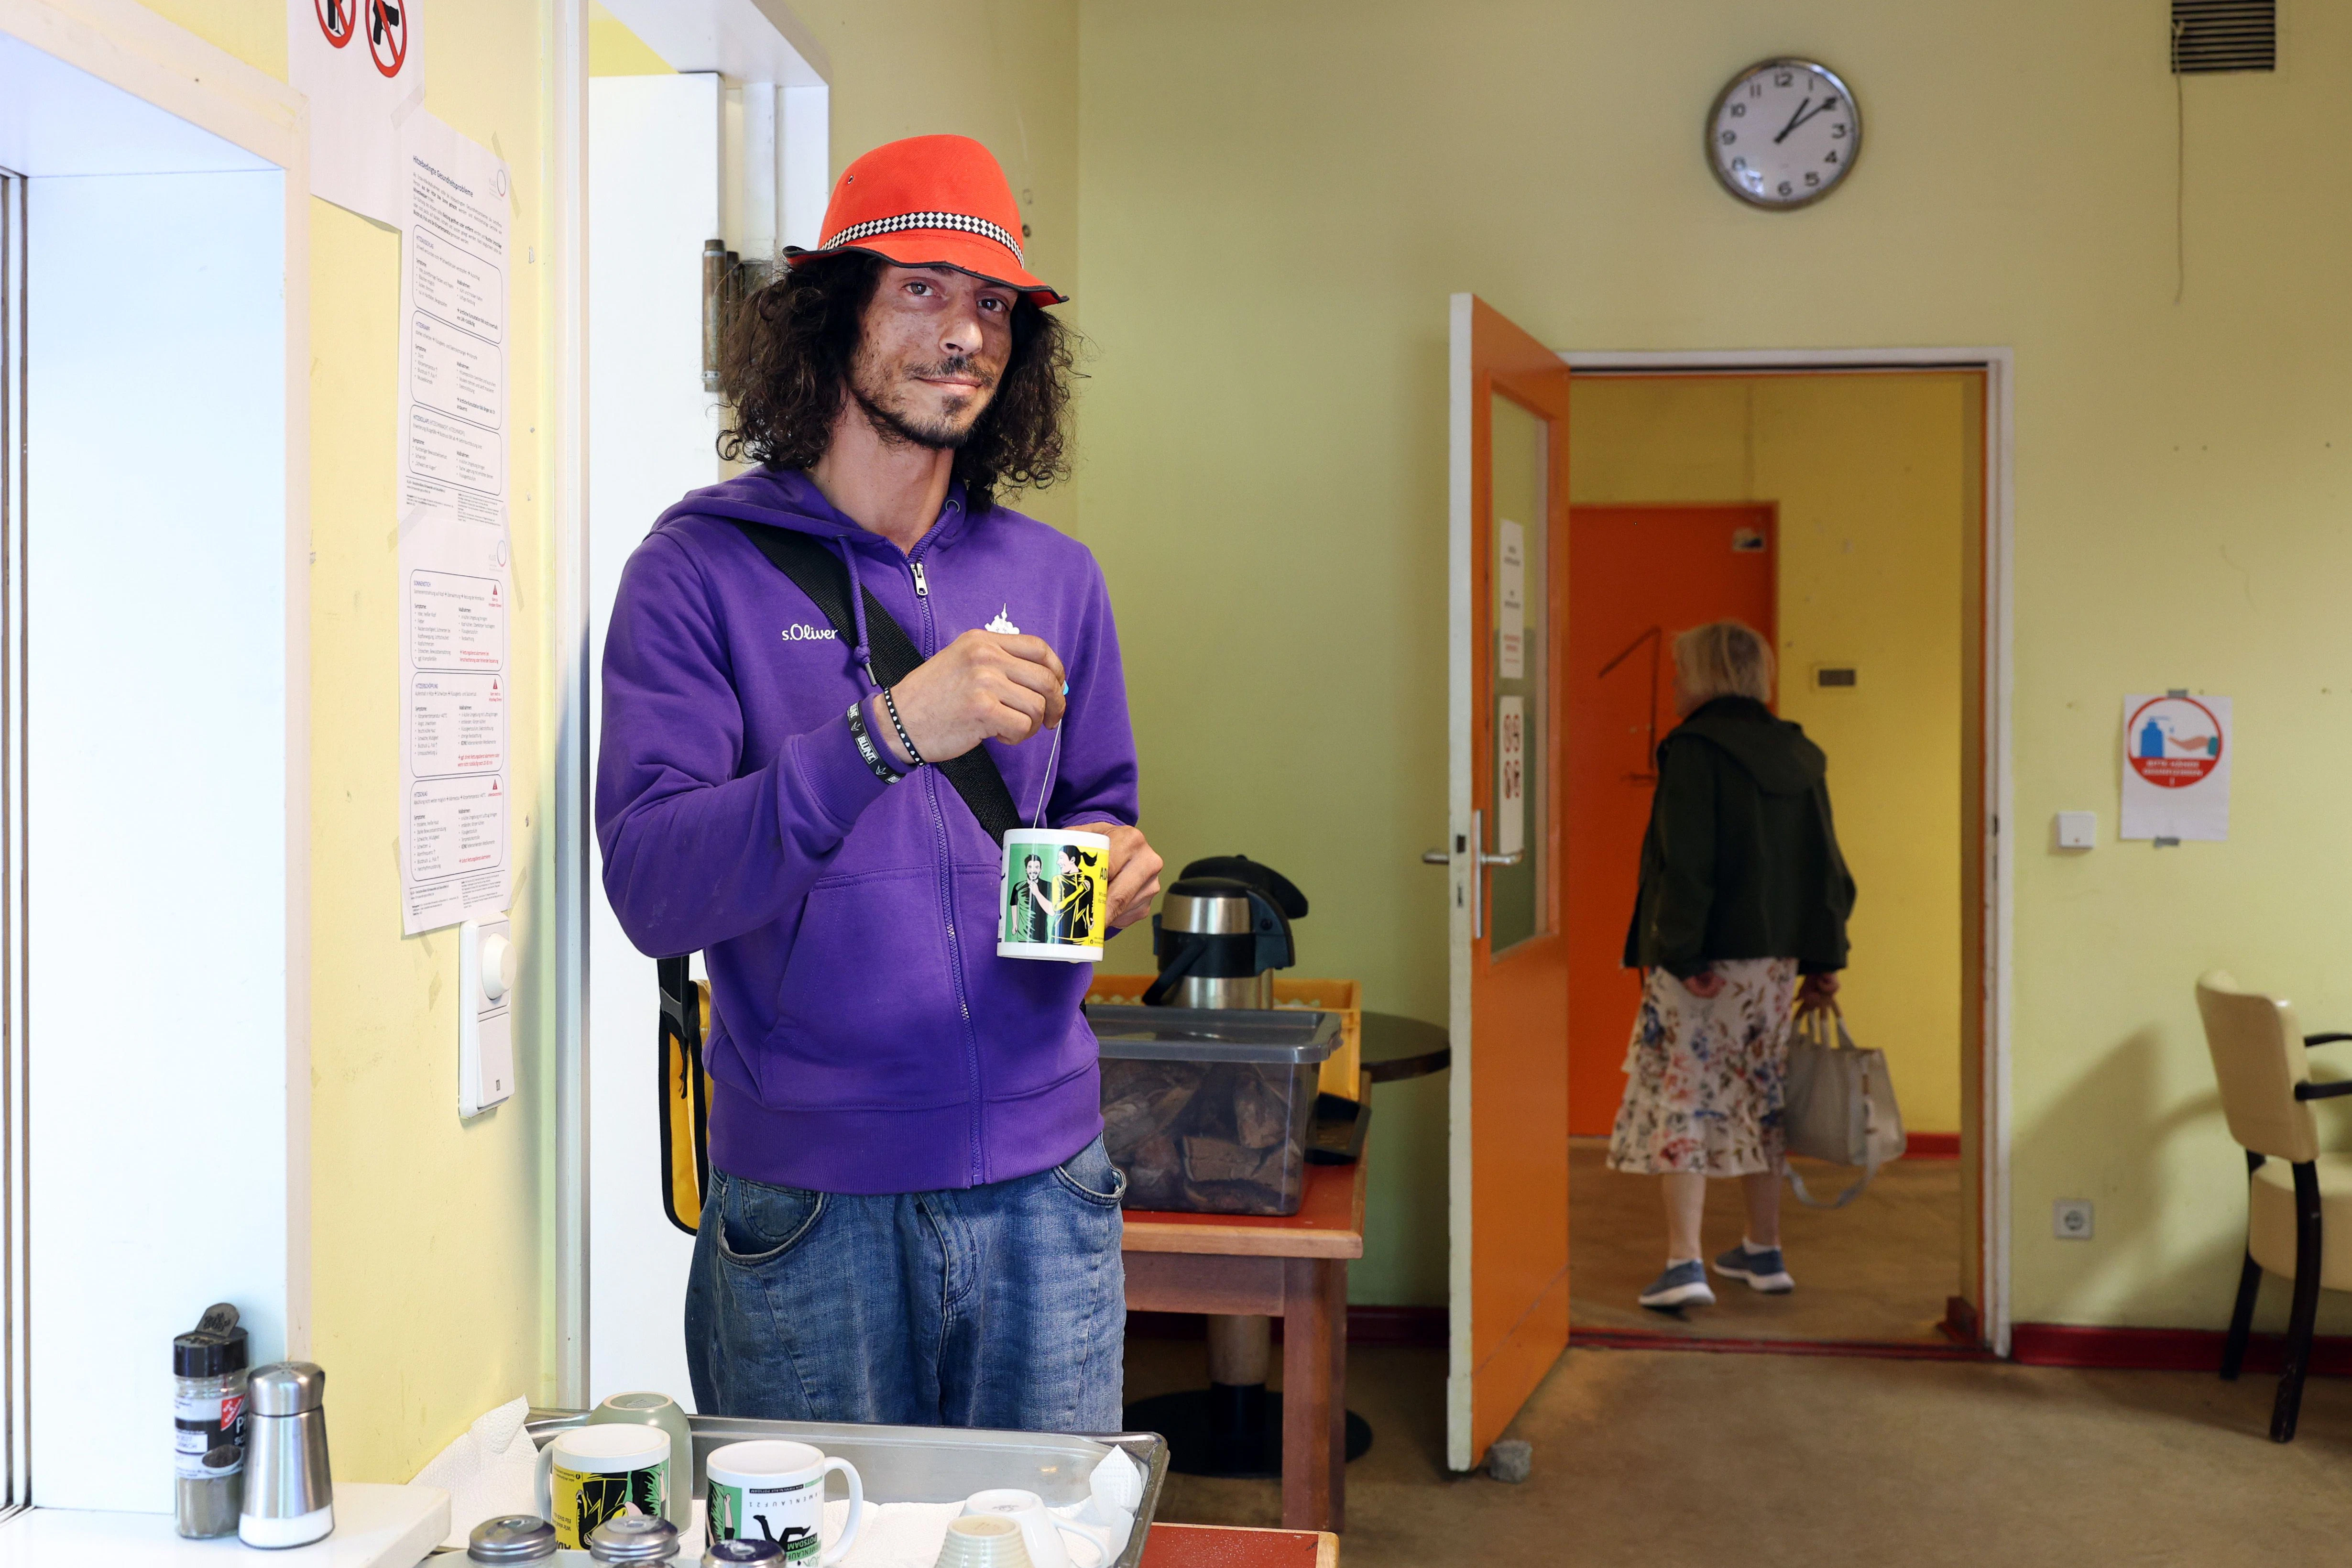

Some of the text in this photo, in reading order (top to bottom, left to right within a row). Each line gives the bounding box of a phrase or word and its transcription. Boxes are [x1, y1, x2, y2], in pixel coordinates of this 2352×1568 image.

[1832, 123, 1847, 139] 3
[1825, 150, 1838, 164] 4
[413, 155, 436, 175] Hitzebedingte
[437, 170, 473, 197] Gesundheitsprobleme
[1805, 171, 1819, 186] 5
[1778, 181, 1792, 197] 6
[781, 623, 839, 641] s.Oliver
[788, 1535, 817, 1550] POTSDAM
